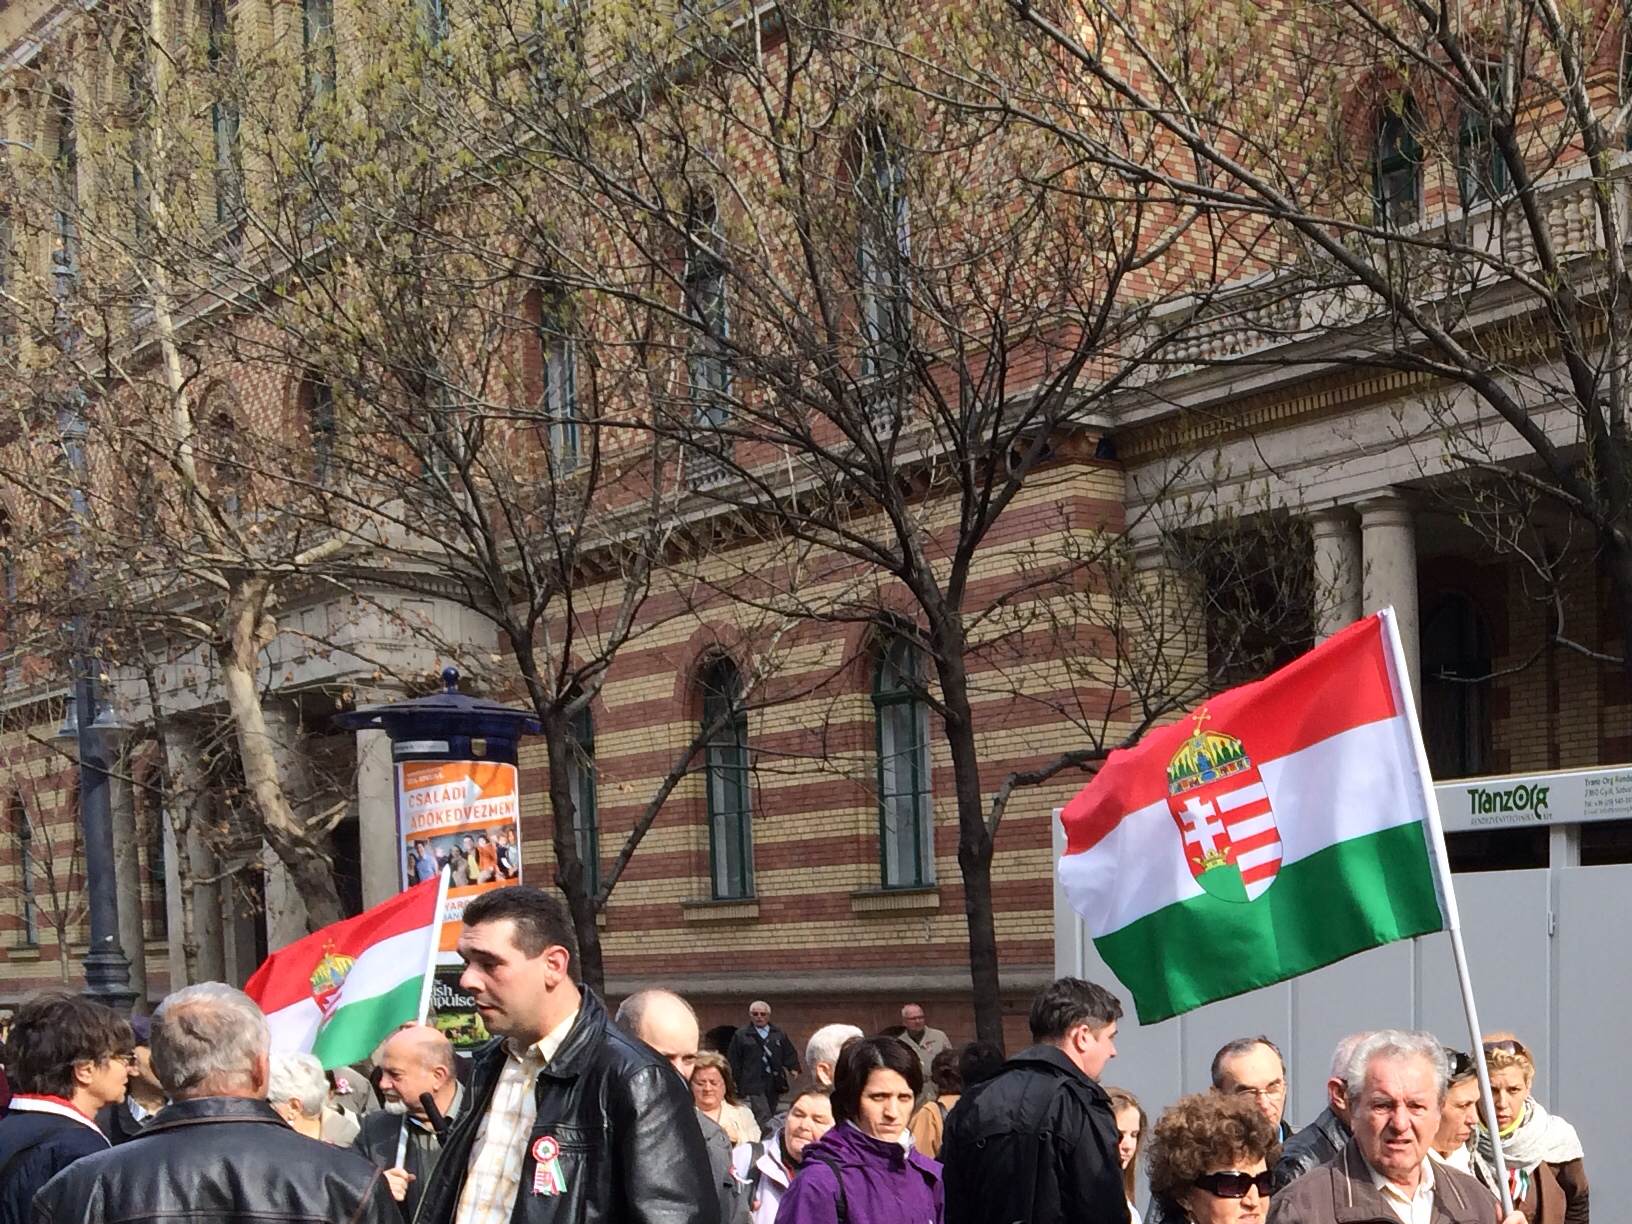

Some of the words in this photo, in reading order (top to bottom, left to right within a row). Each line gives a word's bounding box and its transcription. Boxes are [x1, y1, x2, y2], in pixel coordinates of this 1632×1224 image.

[408, 785, 466, 808] CSALÁDI
[1467, 783, 1550, 820] TranzOrg
[433, 983, 453, 997] ish
